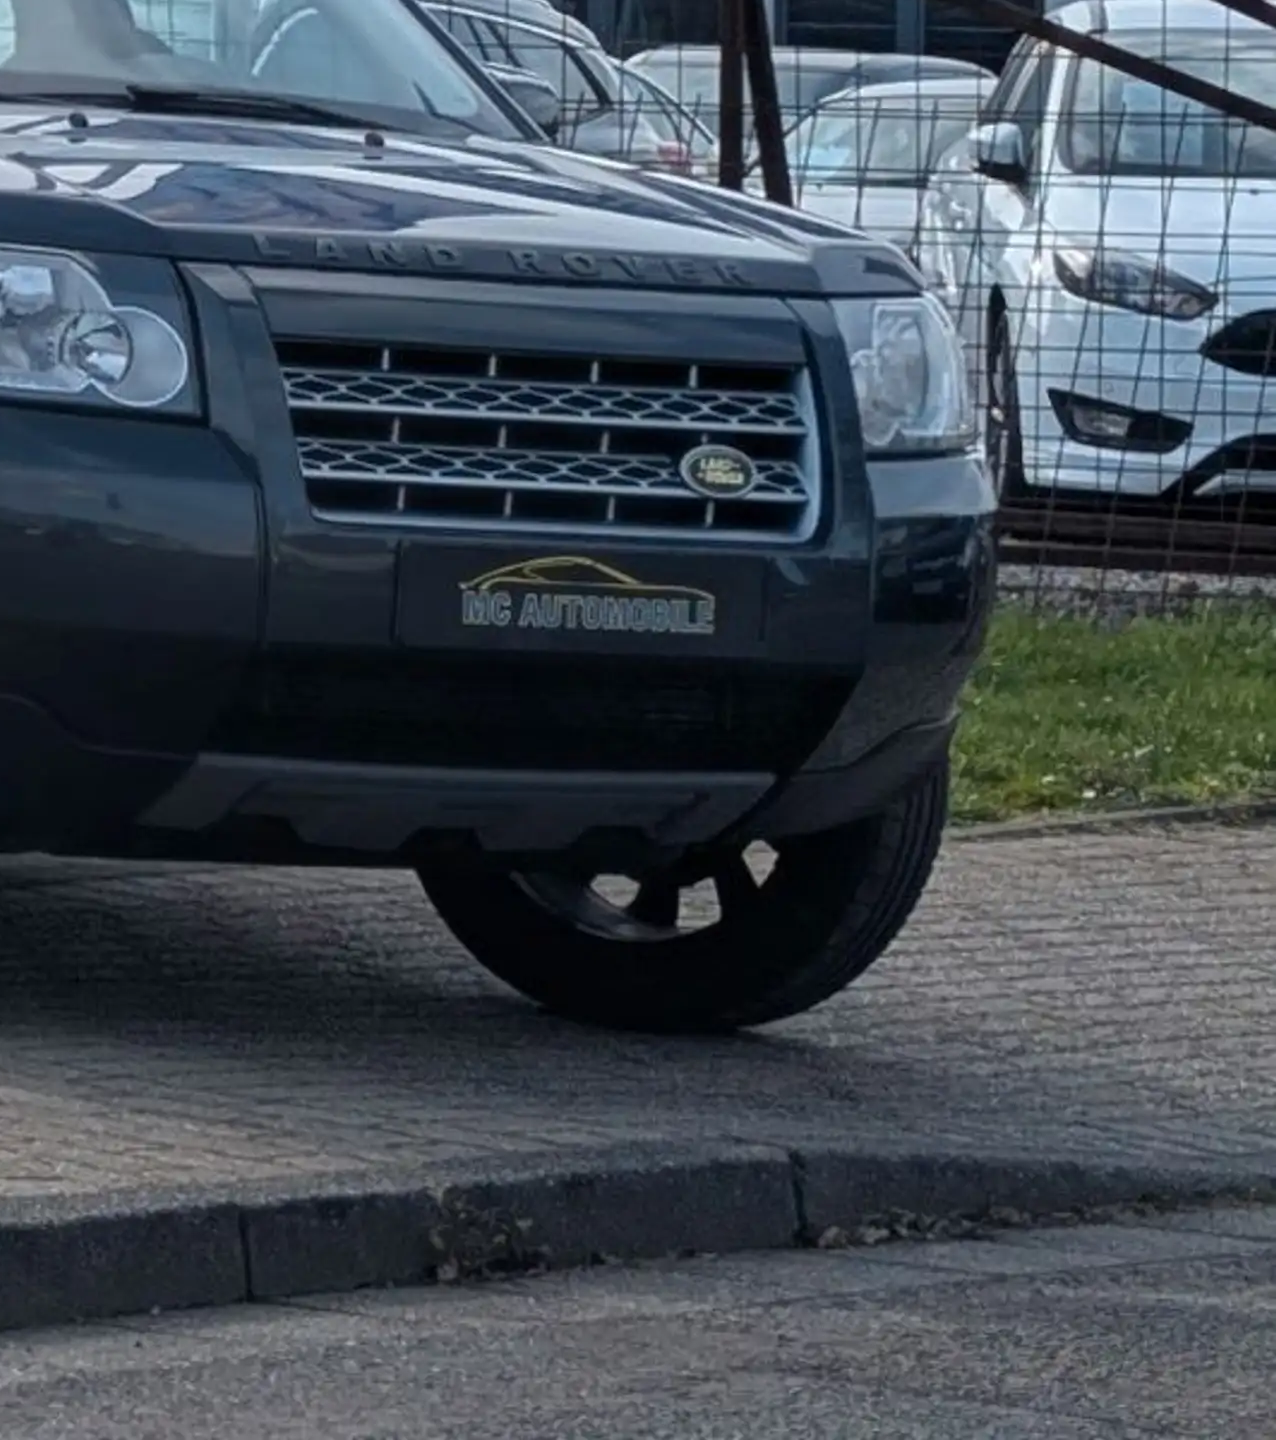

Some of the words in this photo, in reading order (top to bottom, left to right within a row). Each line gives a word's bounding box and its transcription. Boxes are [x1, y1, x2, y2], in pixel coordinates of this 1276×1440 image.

[251, 233, 464, 270] LAND
[506, 248, 753, 286] ROVER
[461, 590, 512, 627] MC
[518, 592, 716, 635] AUTOMOBILE
